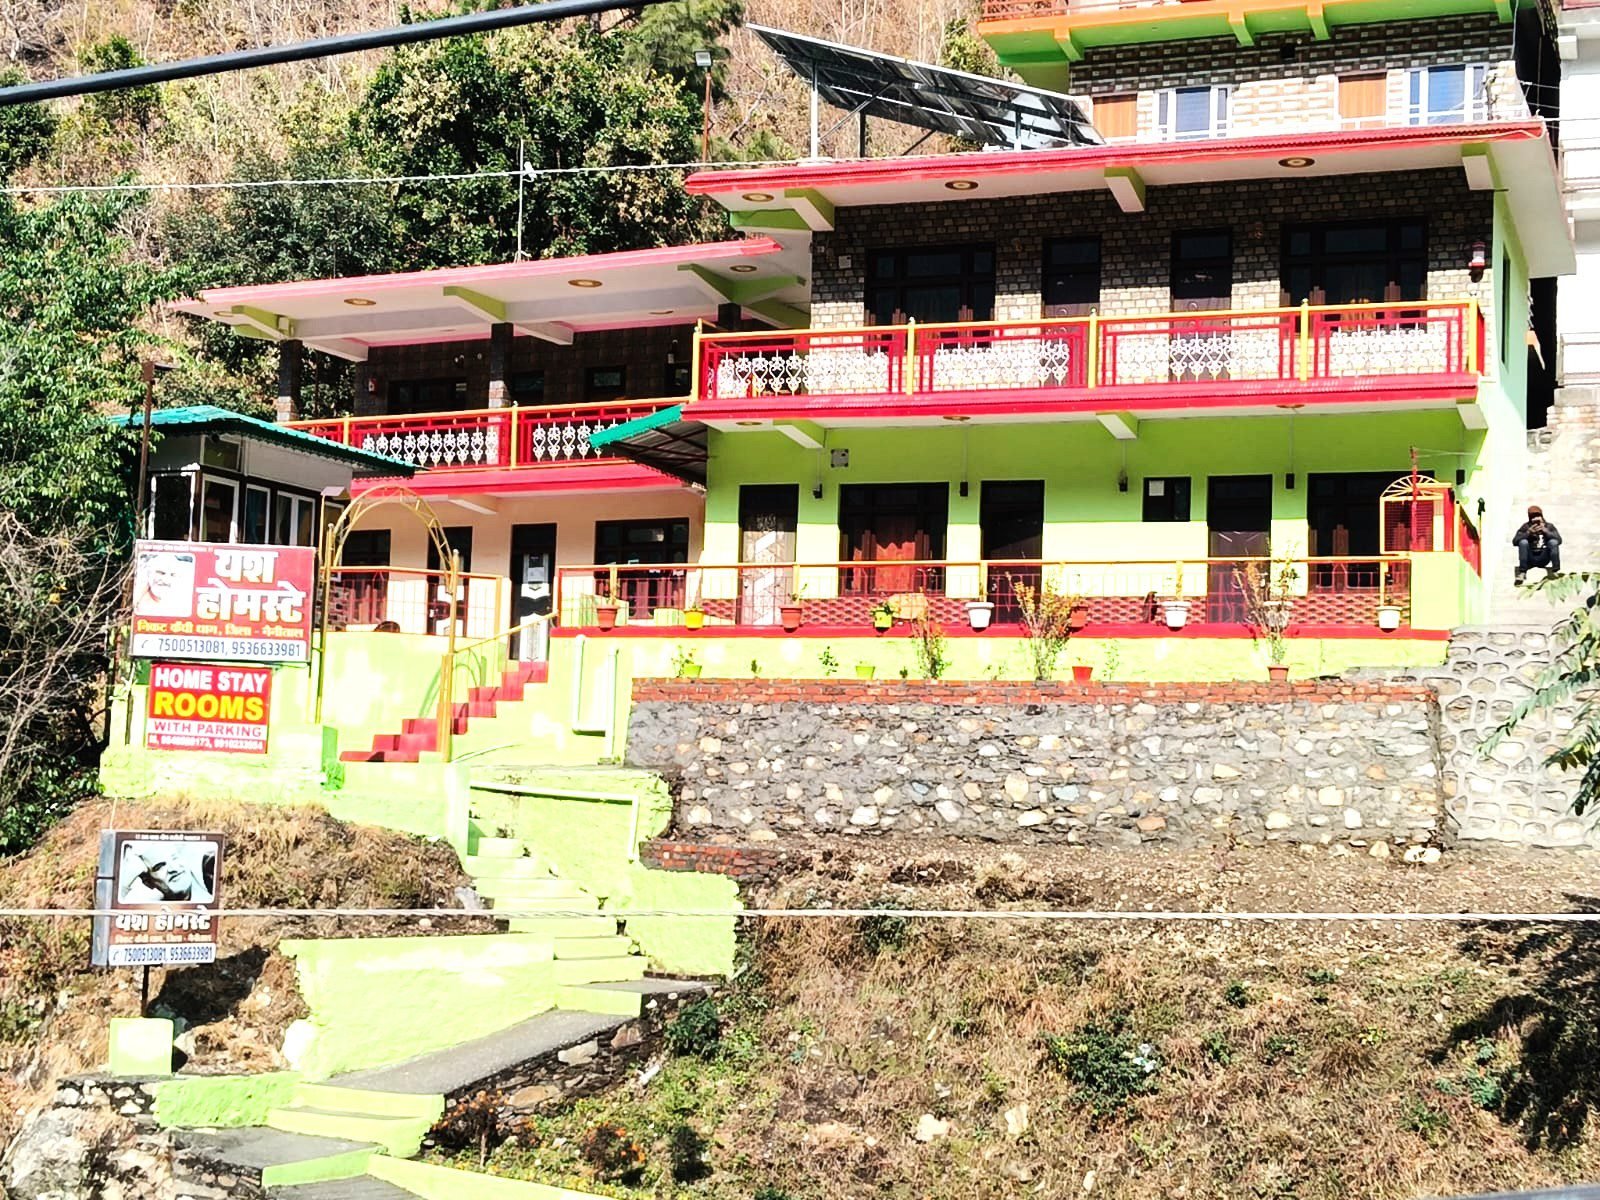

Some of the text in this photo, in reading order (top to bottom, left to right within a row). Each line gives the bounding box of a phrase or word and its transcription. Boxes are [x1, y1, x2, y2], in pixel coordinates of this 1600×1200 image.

[213, 549, 279, 584] यश
[195, 577, 307, 623] होमस्टे
[158, 638, 300, 657] 7500513081, 9536633981
[154, 667, 267, 693] HOME STAY
[154, 691, 264, 721] ROOMS
[154, 720, 262, 738] WITH PARKING
